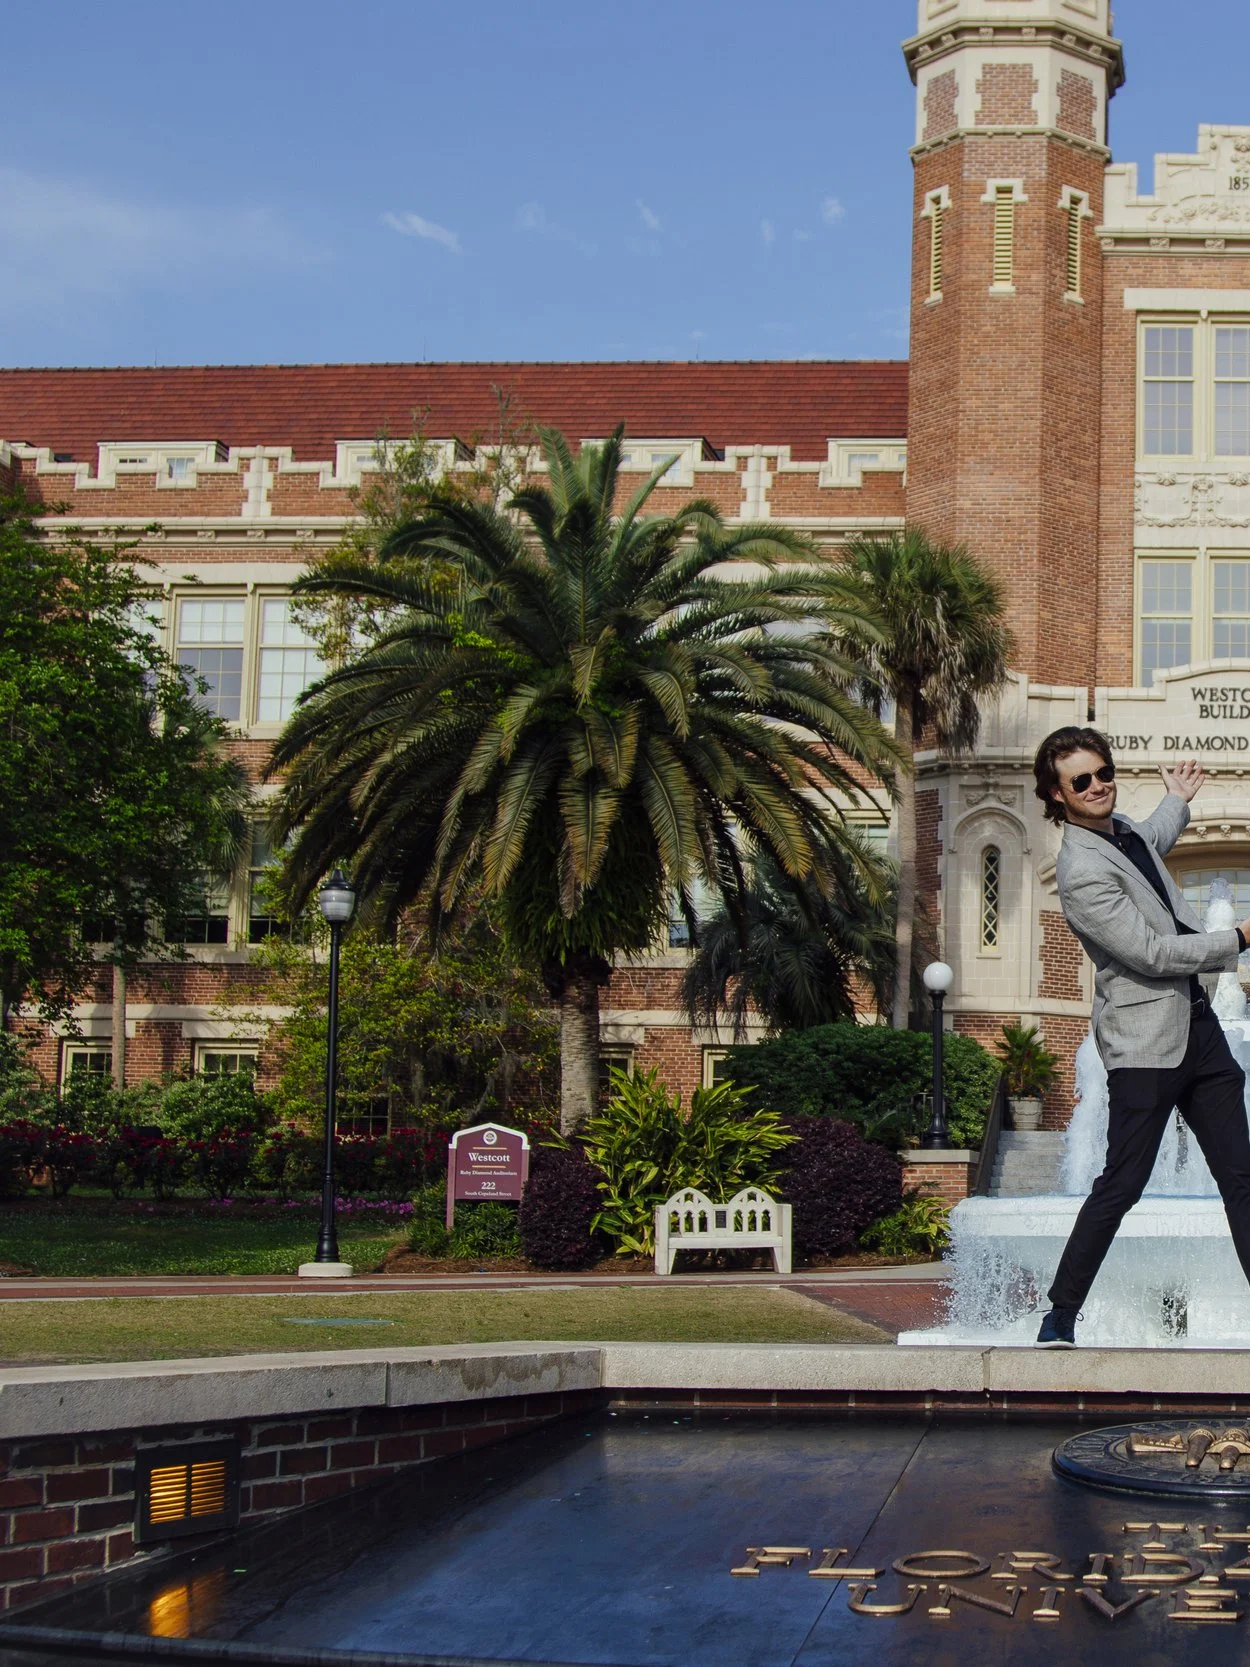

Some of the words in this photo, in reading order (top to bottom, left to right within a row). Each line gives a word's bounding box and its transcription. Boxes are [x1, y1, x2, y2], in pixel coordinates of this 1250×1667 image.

[1106, 735, 1153, 750] RUBY
[1163, 735, 1249, 752] DIAMOND
[468, 1152, 510, 1162] Westcott
[481, 1182, 496, 1190] 222
